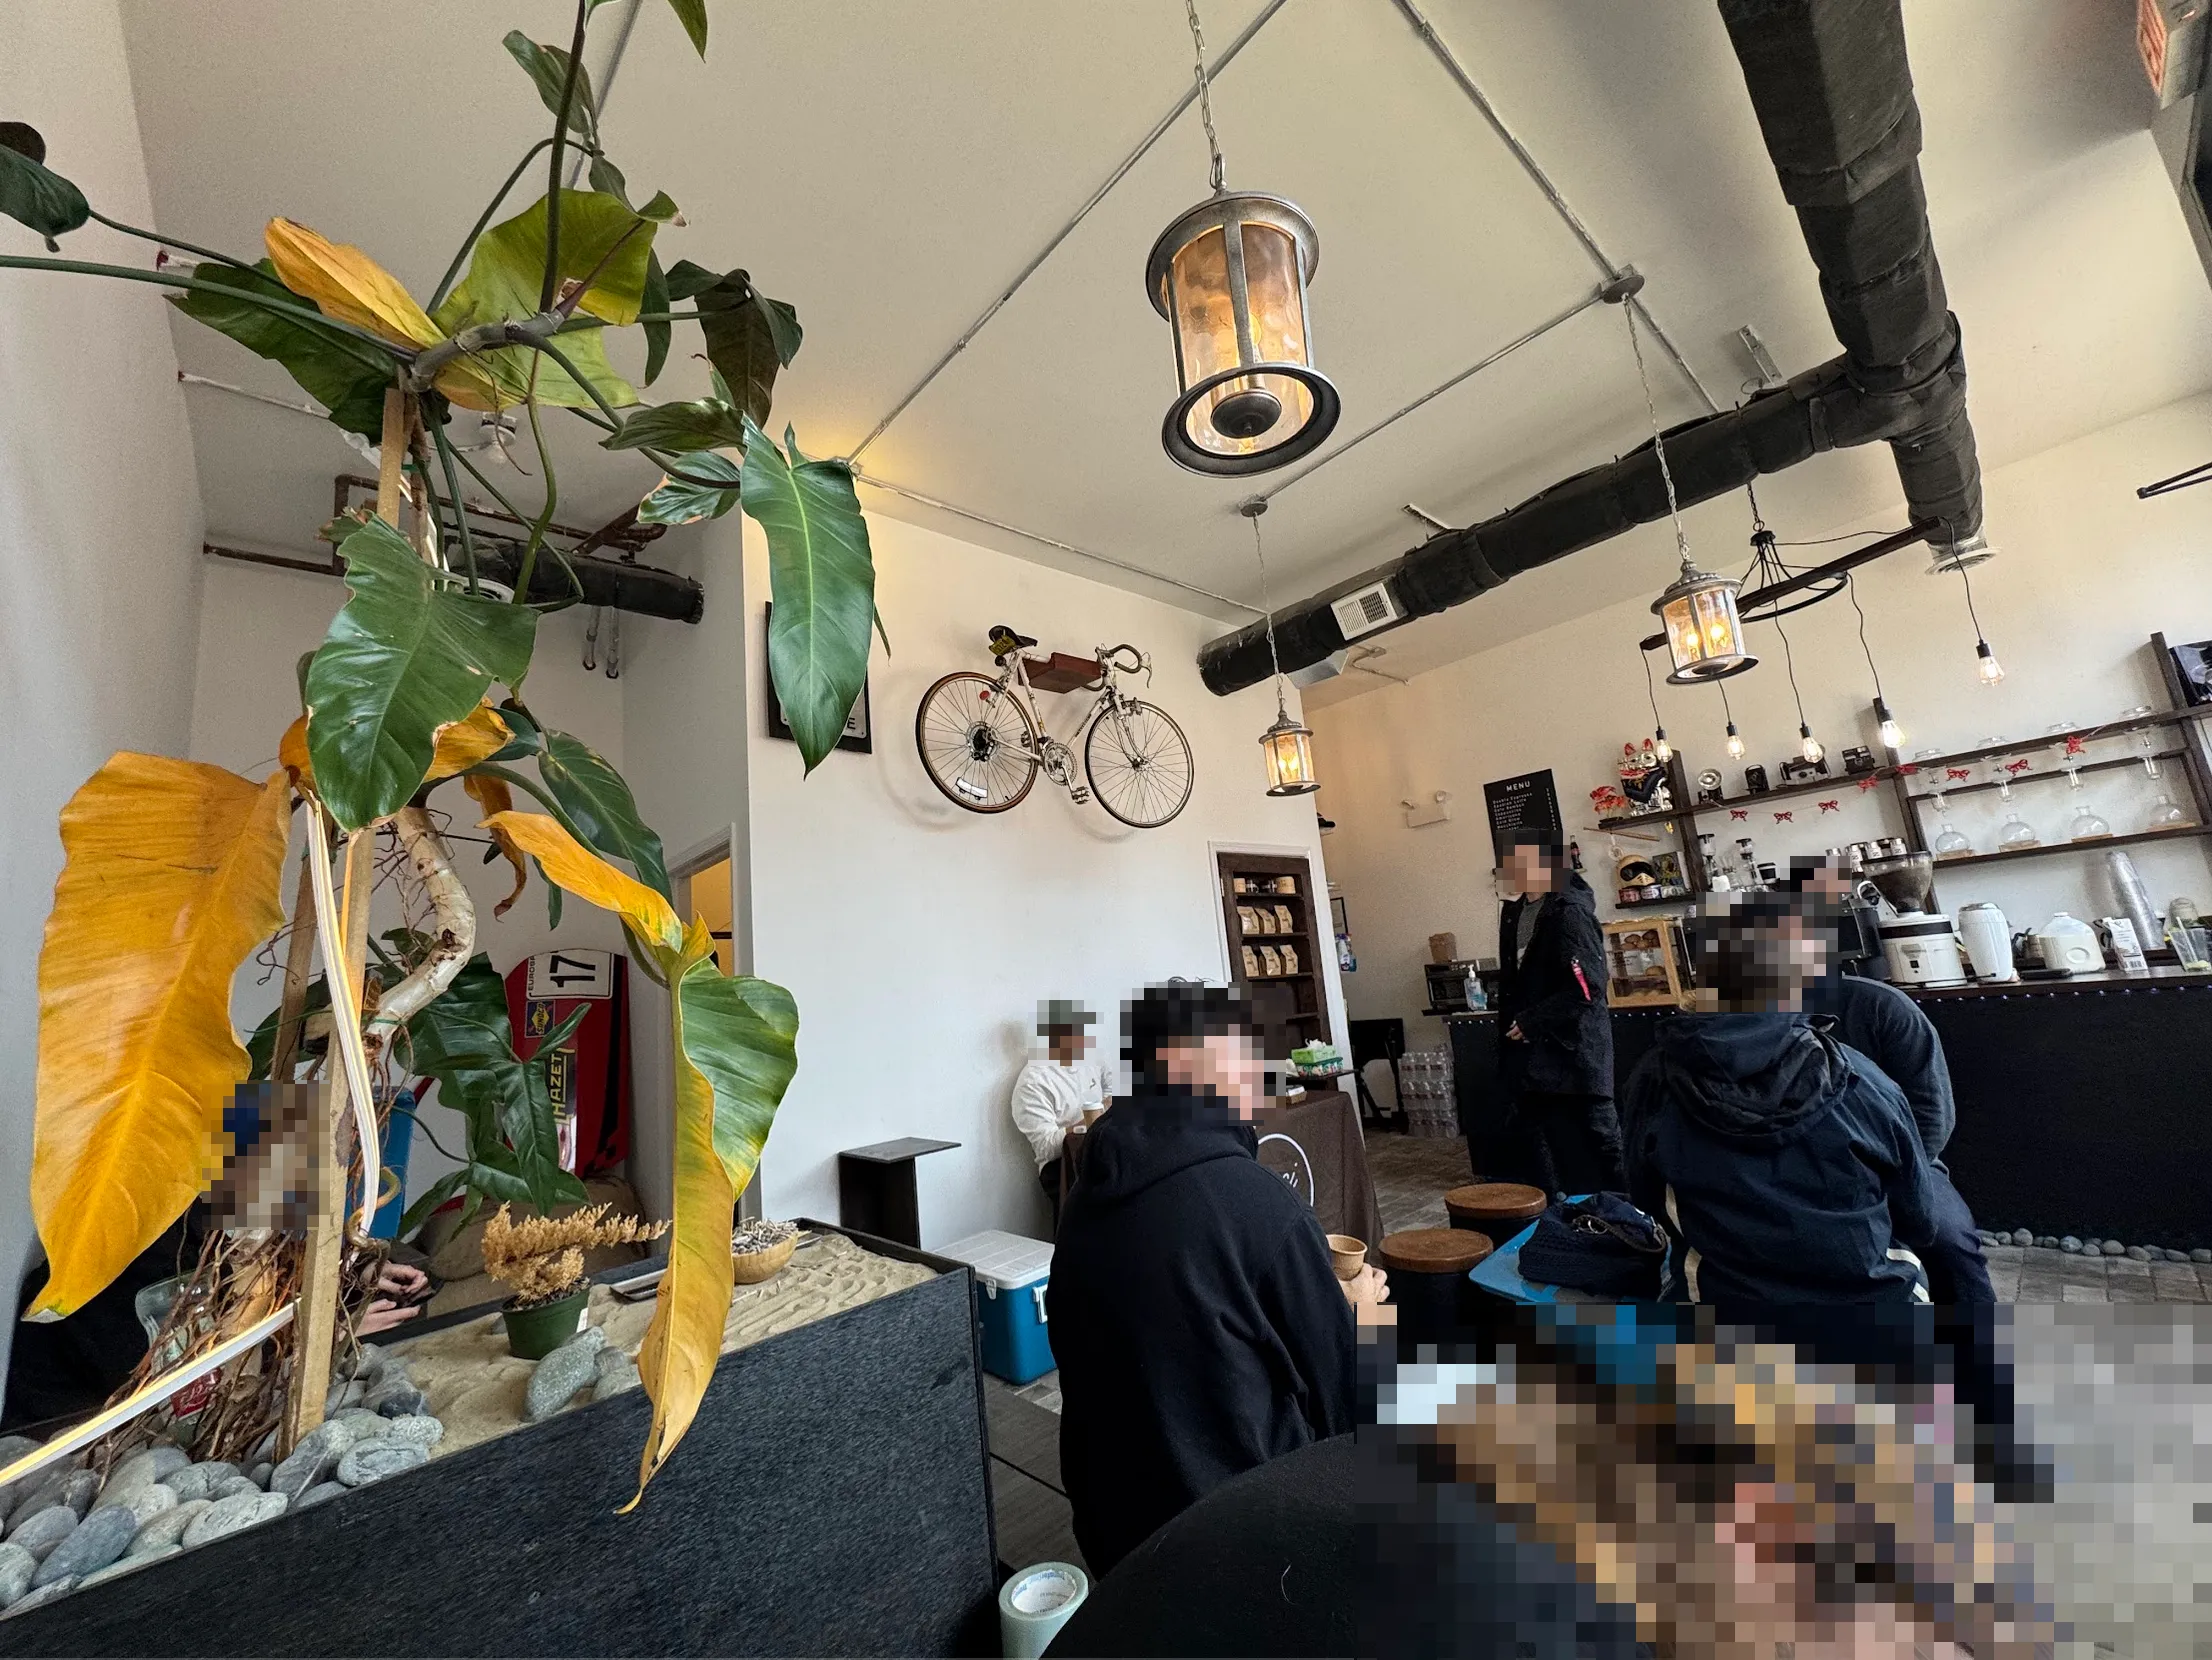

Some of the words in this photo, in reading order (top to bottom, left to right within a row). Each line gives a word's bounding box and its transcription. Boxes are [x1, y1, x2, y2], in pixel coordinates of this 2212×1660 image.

[1506, 781, 1531, 792] MENU
[549, 954, 596, 988] 17
[536, 1003, 545, 1033] SUNOCO
[550, 1053, 567, 1118] HAZET
